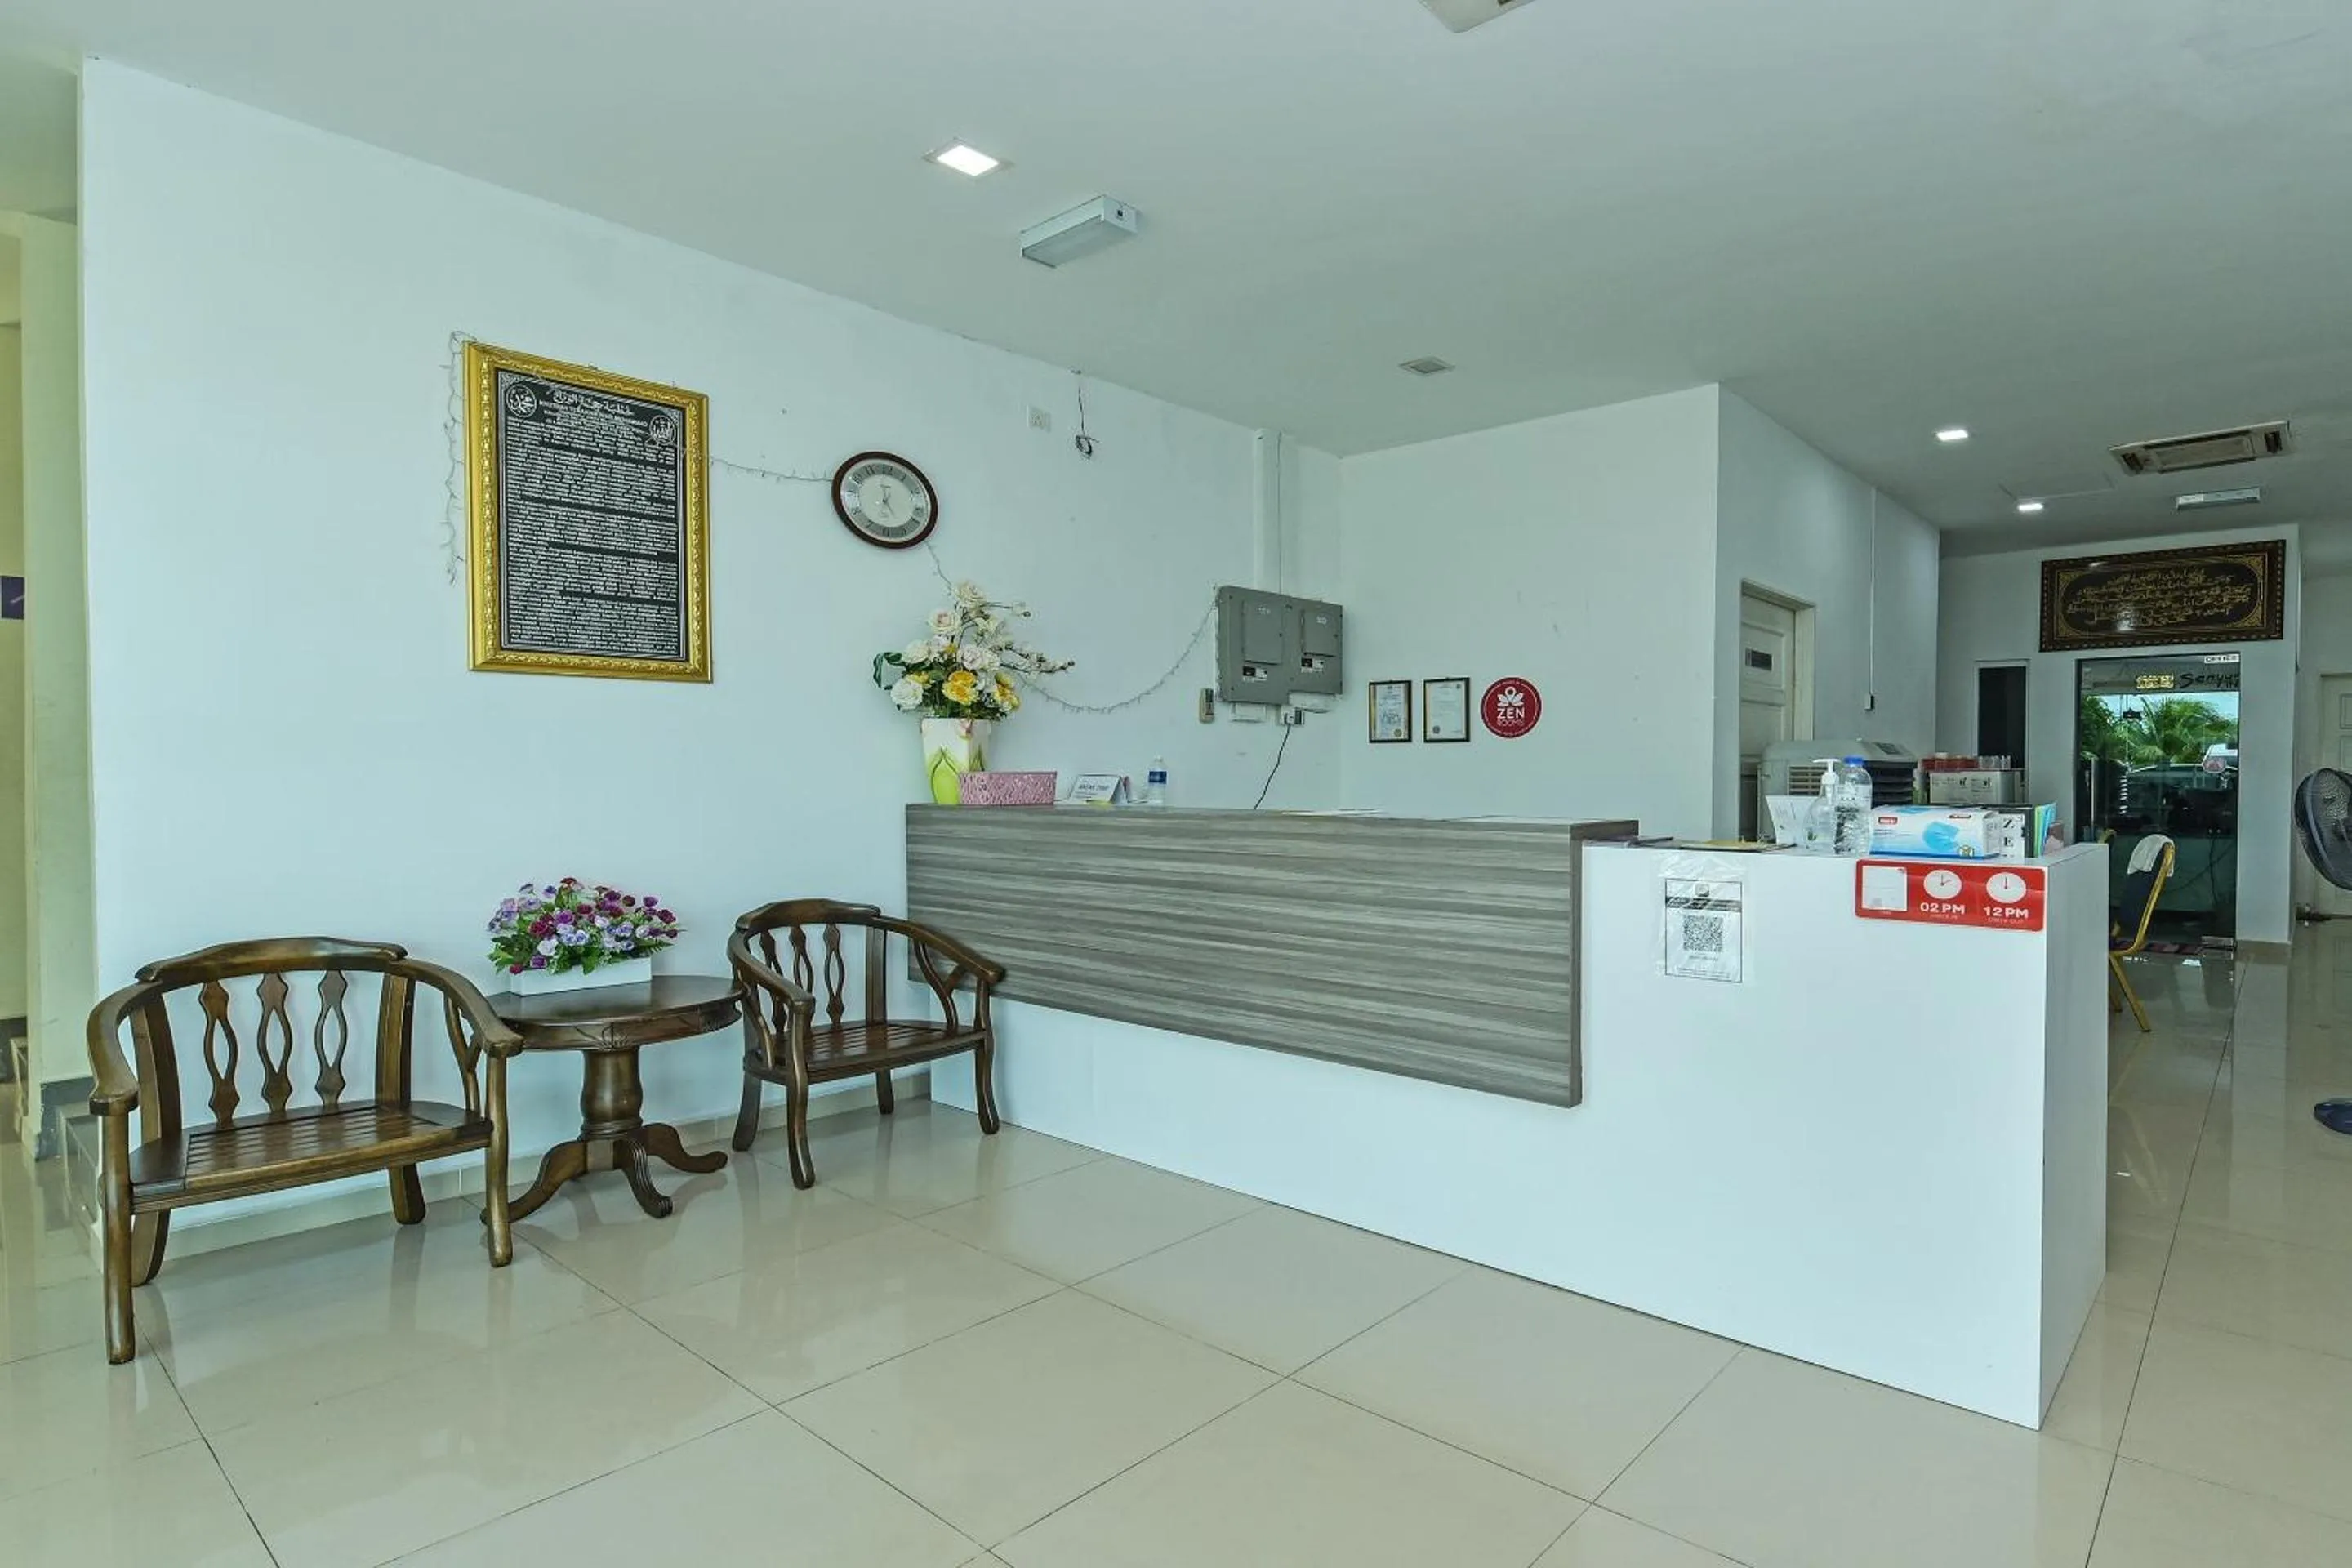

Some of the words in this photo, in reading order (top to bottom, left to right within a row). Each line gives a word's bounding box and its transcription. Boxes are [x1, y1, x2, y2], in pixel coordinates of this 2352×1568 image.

[1496, 707, 1525, 719] ZEN
[1920, 902, 1939, 913] 02
[1941, 903, 1966, 915] PM
[1983, 906, 2003, 916] 12
[2005, 907, 2029, 918] PM
